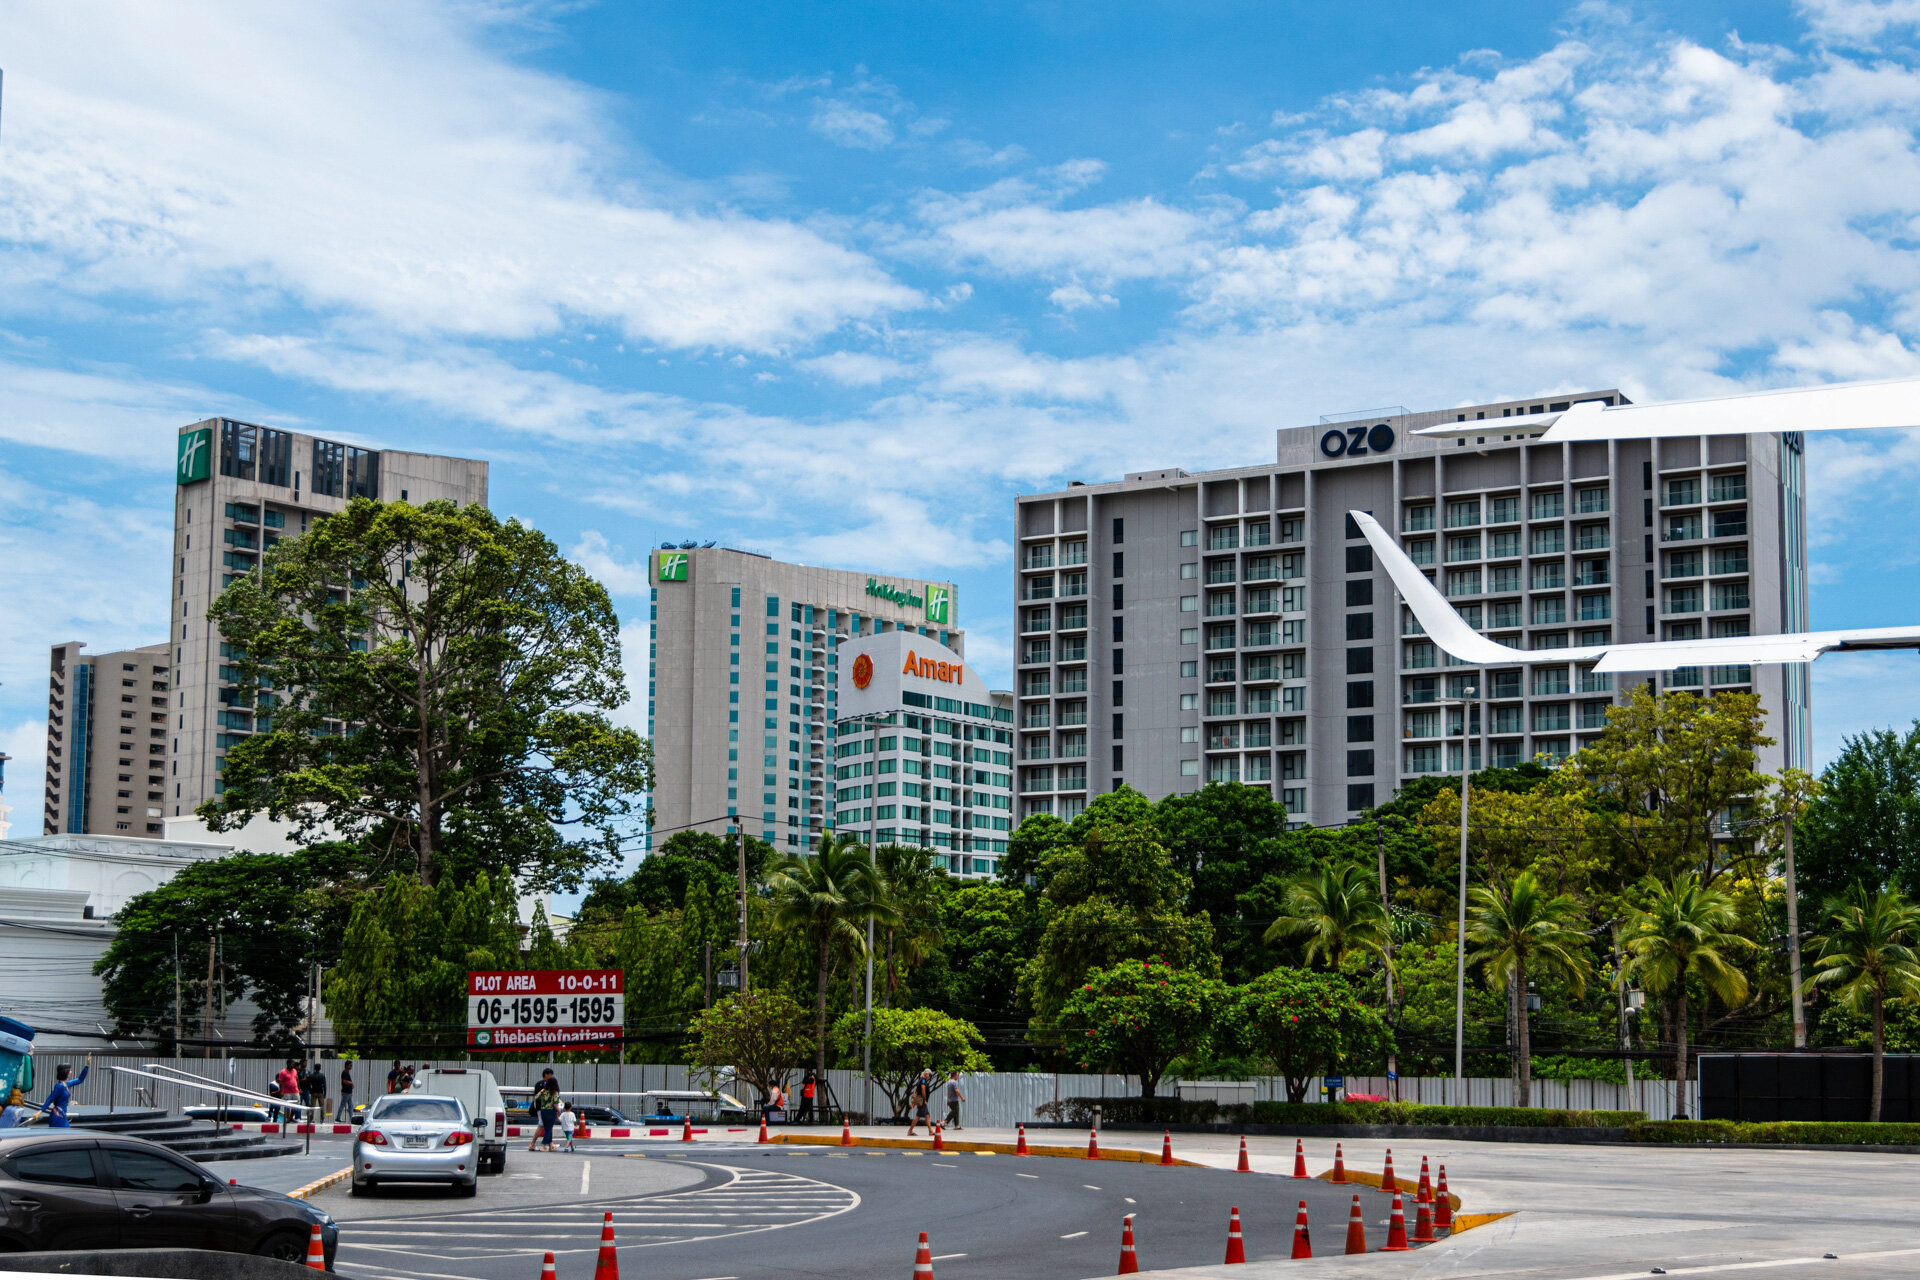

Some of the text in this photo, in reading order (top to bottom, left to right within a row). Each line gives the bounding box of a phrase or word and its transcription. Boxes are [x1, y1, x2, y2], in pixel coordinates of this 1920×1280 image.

[1320, 424, 1395, 458] OZO
[866, 577, 923, 608] Holiday Inn
[902, 650, 963, 685] Amari
[475, 974, 617, 991] PLOT AREA 10-0-11
[477, 997, 615, 1025] 06-1595-1595
